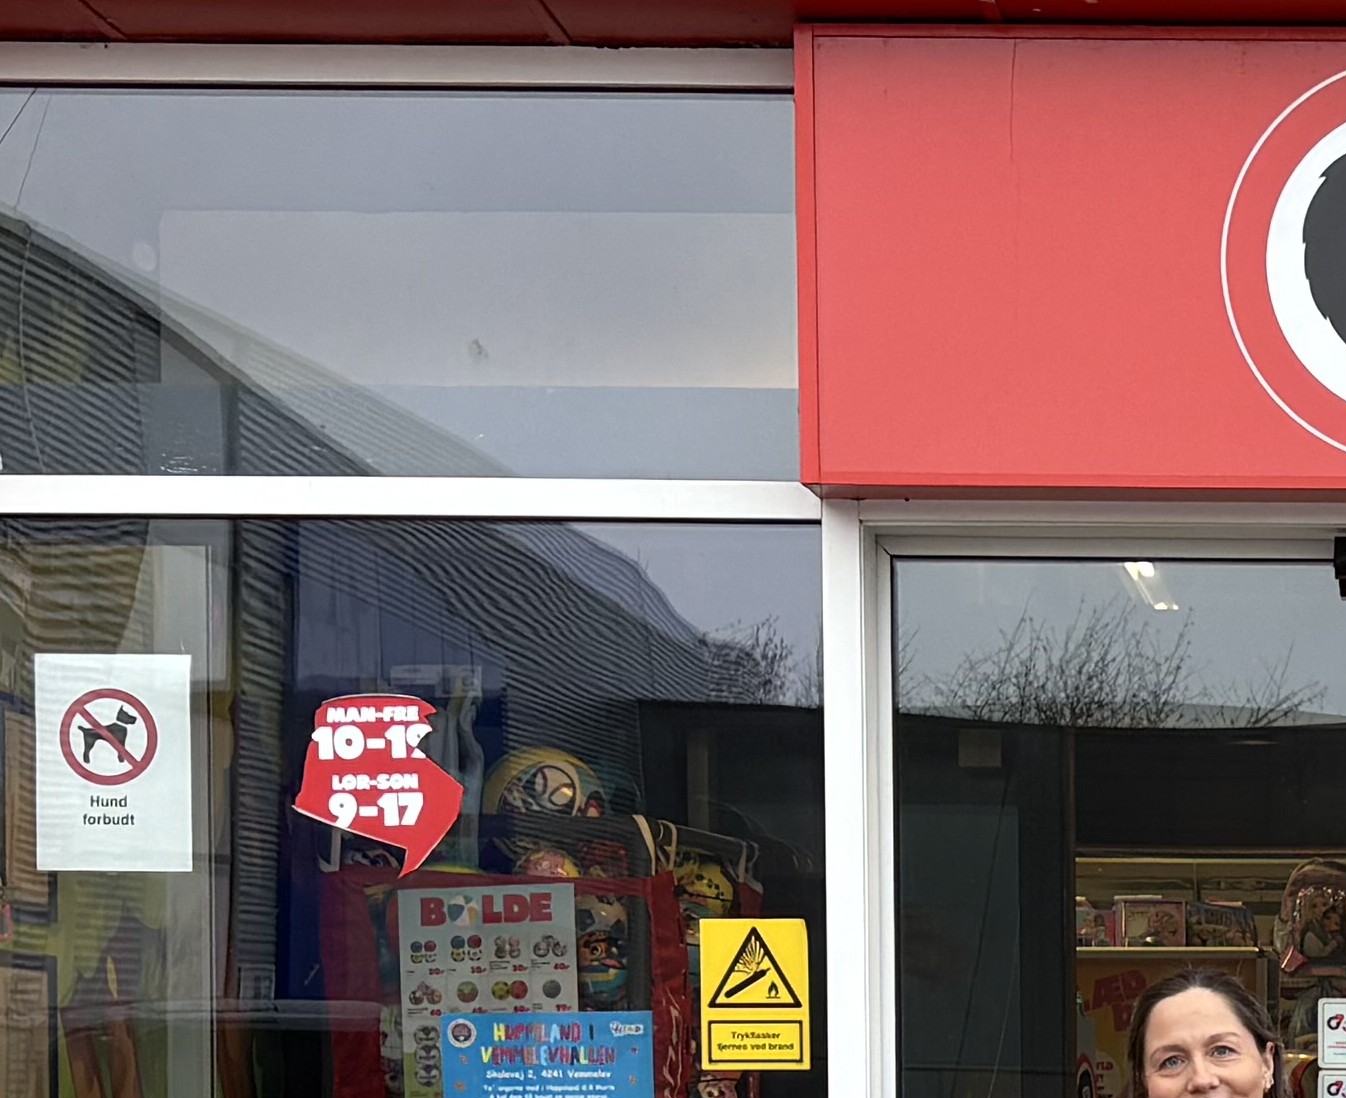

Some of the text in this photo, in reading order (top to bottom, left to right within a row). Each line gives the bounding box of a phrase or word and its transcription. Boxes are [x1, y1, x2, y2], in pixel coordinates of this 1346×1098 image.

[327, 705, 419, 723] MAN-FRE
[90, 795, 127, 807] Hund
[328, 792, 423, 828] 9-17
[83, 813, 135, 825] forbudt
